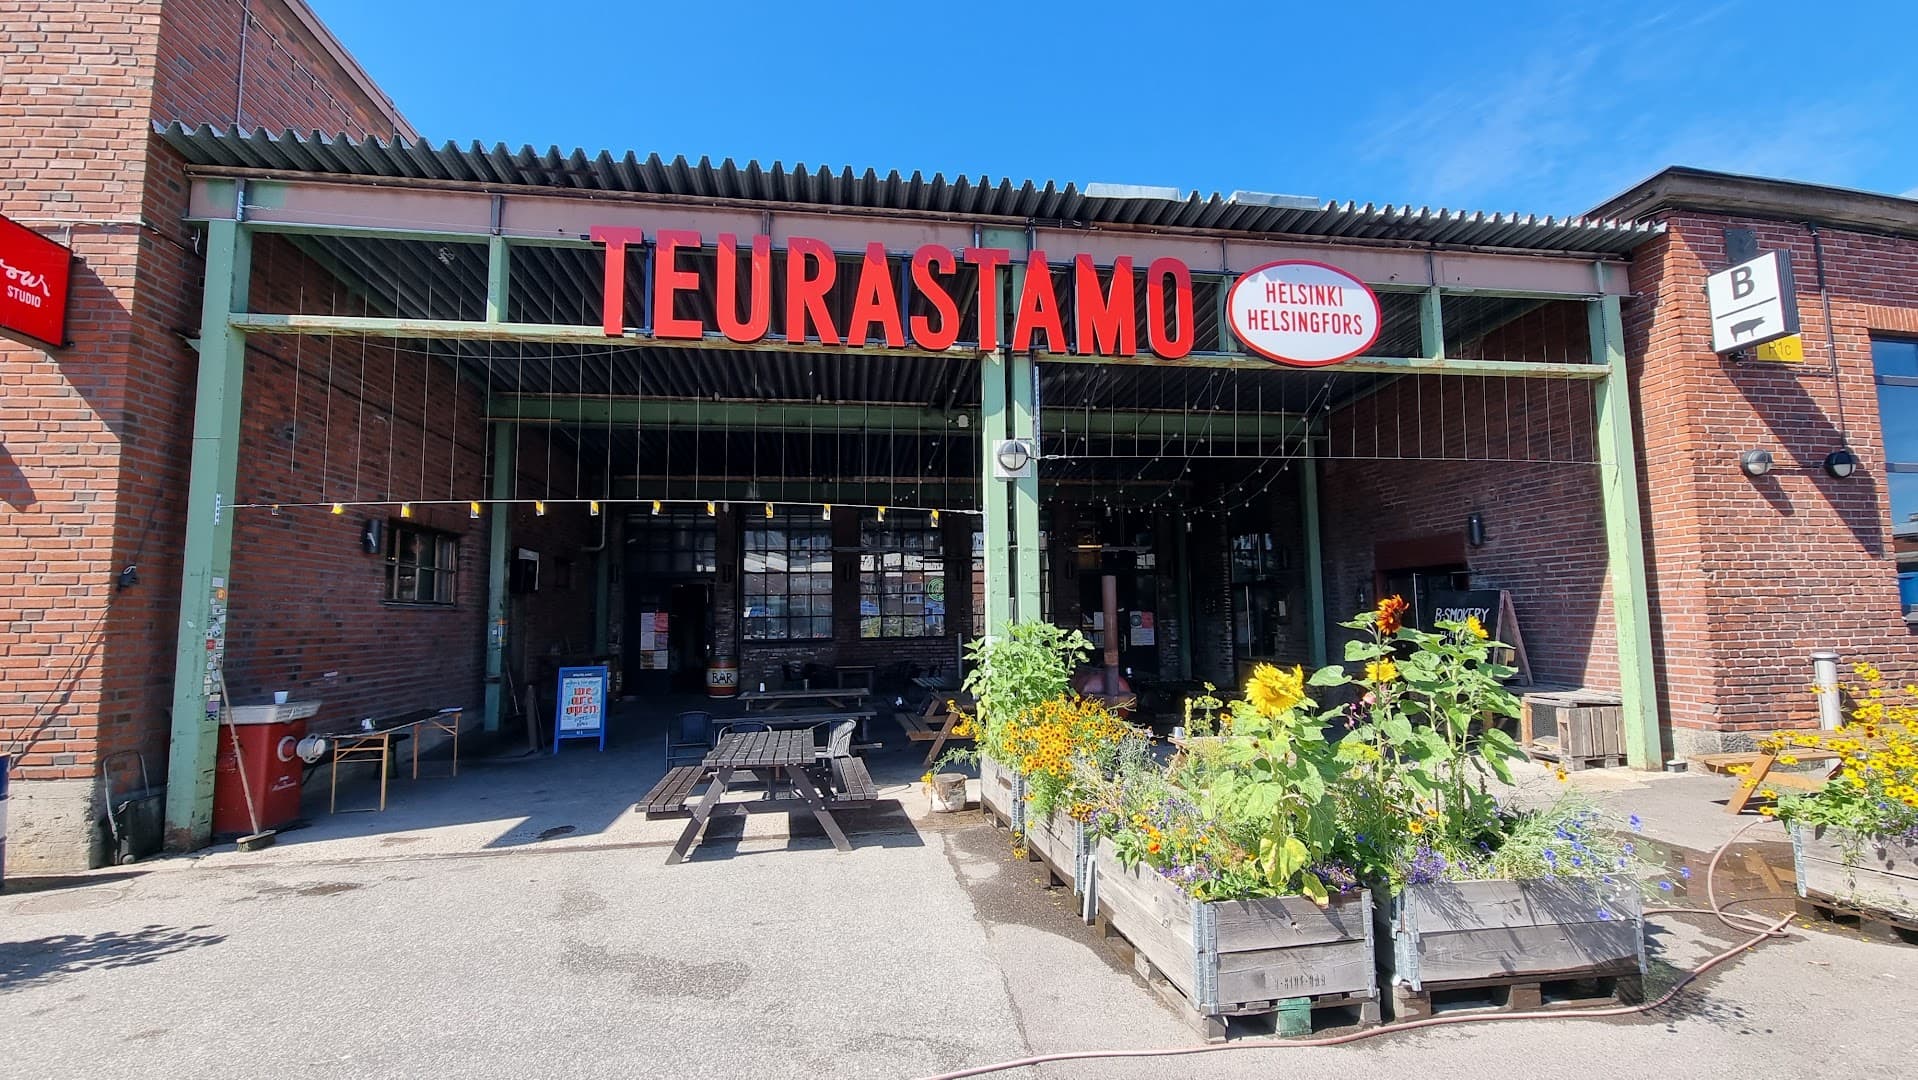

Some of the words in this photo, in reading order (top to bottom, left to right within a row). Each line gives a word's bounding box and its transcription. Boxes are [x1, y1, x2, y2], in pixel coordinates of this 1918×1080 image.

[590, 226, 1194, 360] TEURASTAMO
[1265, 282, 1344, 306] HELSINKI
[1730, 266, 1755, 300] B
[7, 285, 41, 308] STUDIO
[1247, 309, 1363, 336] HELSINGFORS
[711, 672, 734, 684] BAR
